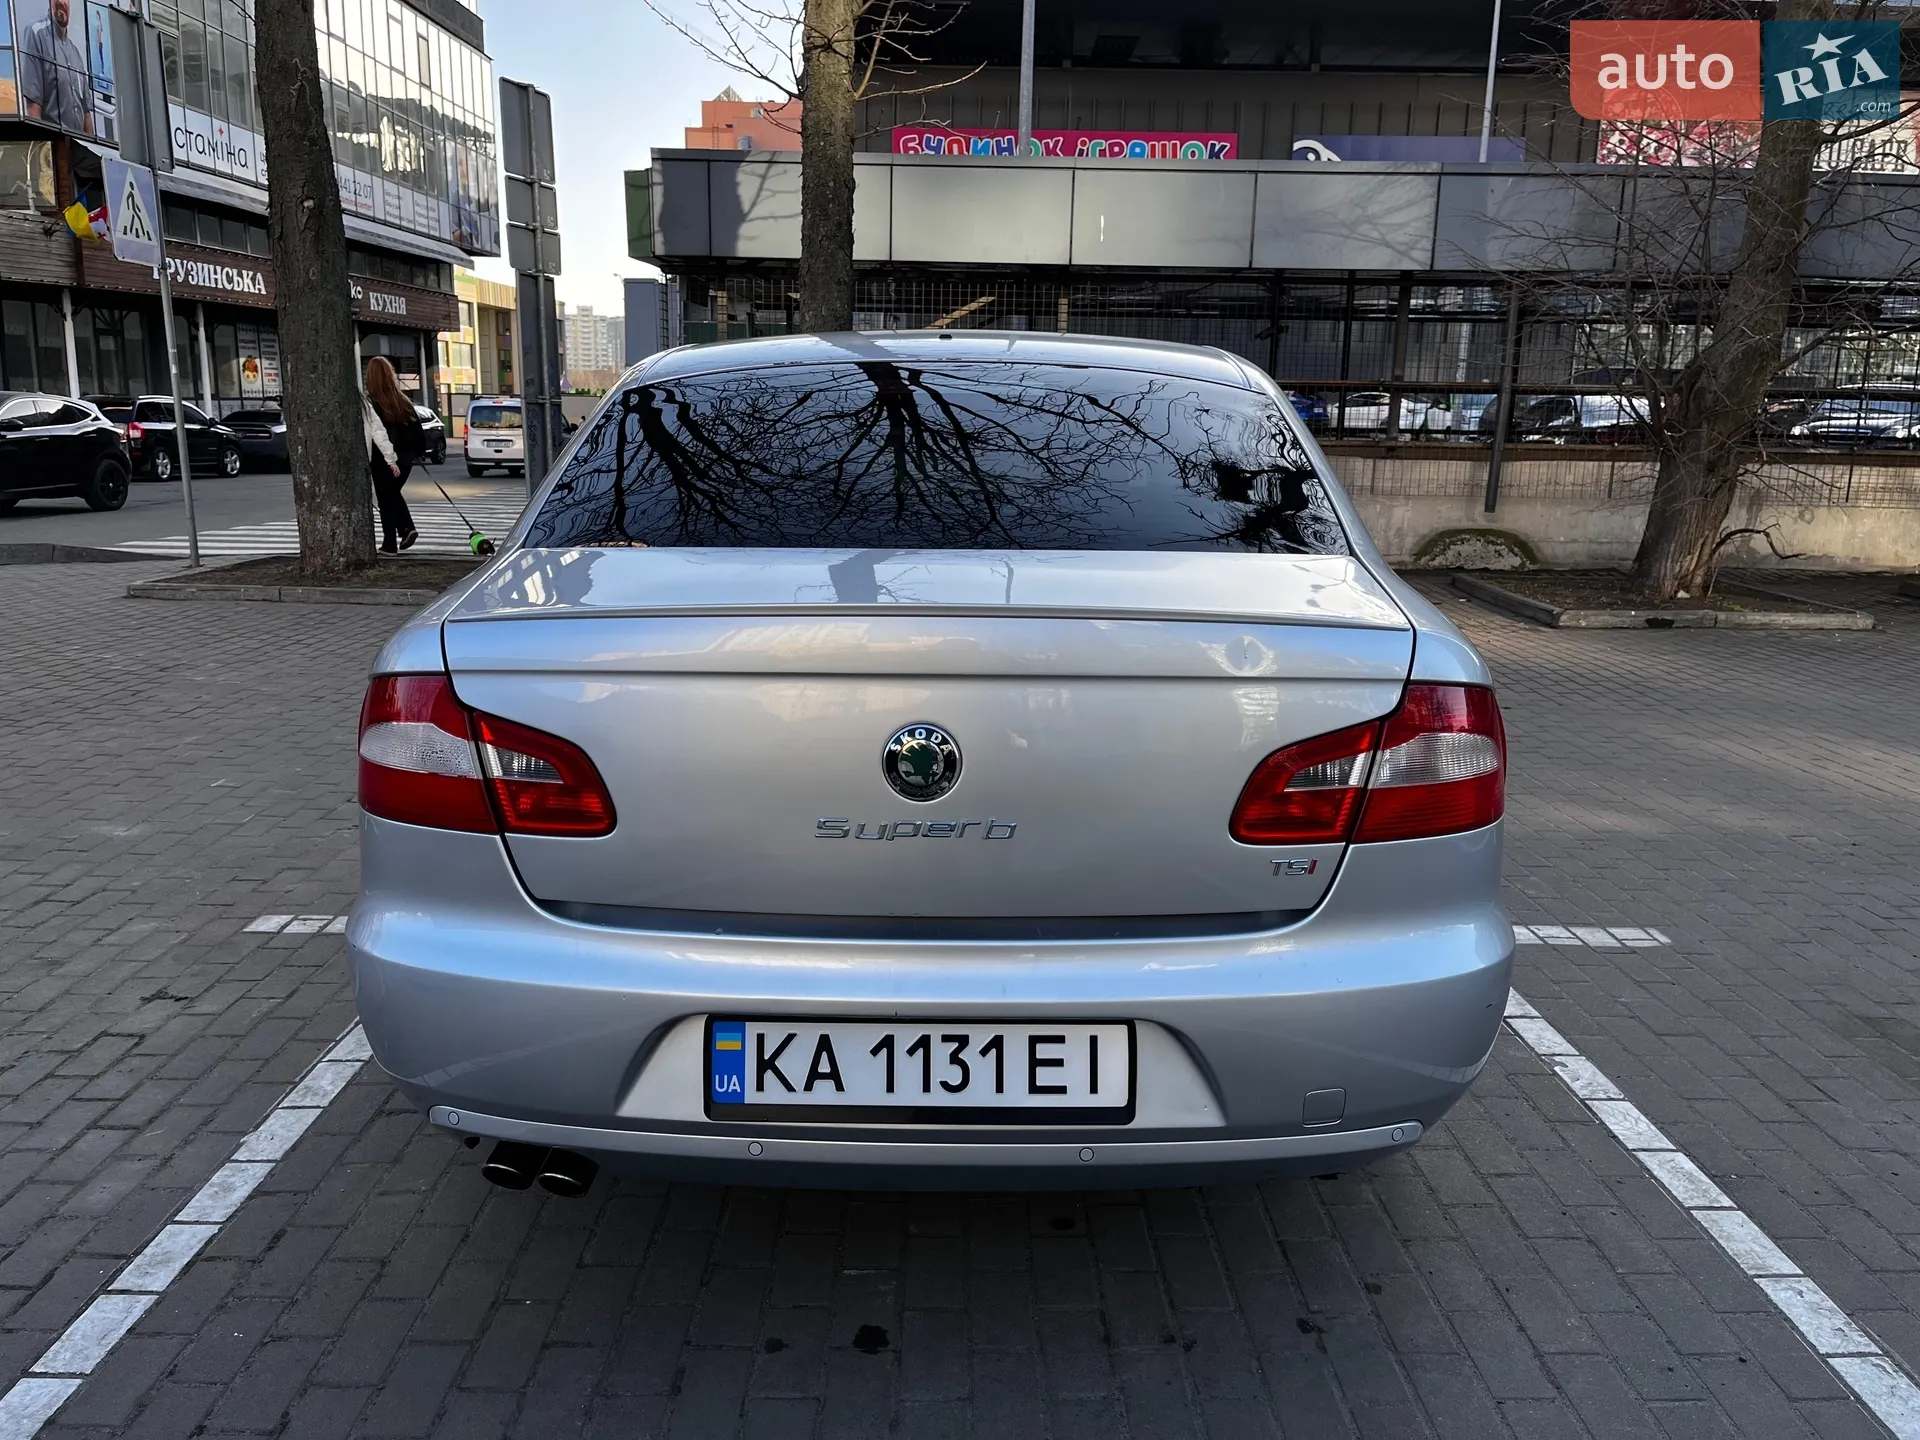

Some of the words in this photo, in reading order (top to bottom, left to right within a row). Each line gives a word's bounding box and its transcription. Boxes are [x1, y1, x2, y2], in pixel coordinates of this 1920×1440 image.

[369, 291, 407, 315] КУХНЯ
[815, 817, 1018, 841] Superb
[1269, 857, 1318, 876] TSI
[714, 1074, 741, 1093] UA
[755, 1032, 846, 1093] KA
[869, 1034, 1005, 1095] 1131
[1028, 1034, 1099, 1095] EI
